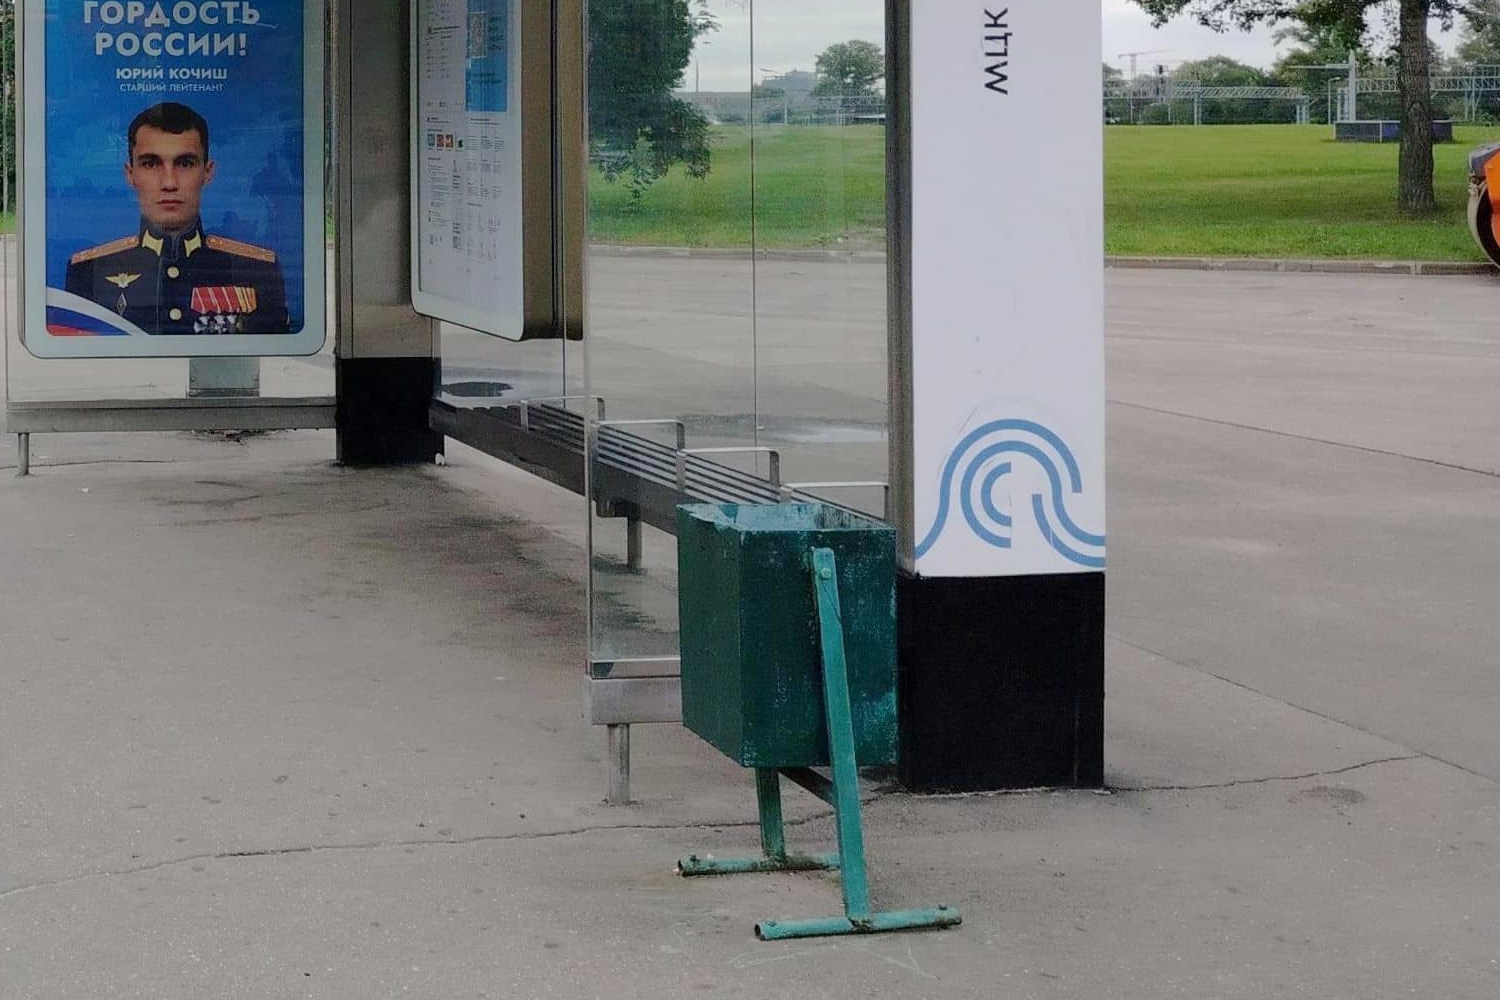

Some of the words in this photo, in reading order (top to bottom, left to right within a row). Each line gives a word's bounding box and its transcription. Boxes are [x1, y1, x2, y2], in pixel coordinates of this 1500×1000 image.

[83, 1, 260, 27] ГОРДОСТЬ
[95, 32, 247, 57] РОССИИ!
[984, 8, 1013, 95] МЦК
[116, 65, 164, 79] ЮРИЙ
[169, 68, 228, 80] КОЧИШ
[120, 82, 167, 92] СТАРШИЙ
[169, 82, 224, 92] ЛЕЙТЕНАНТ
